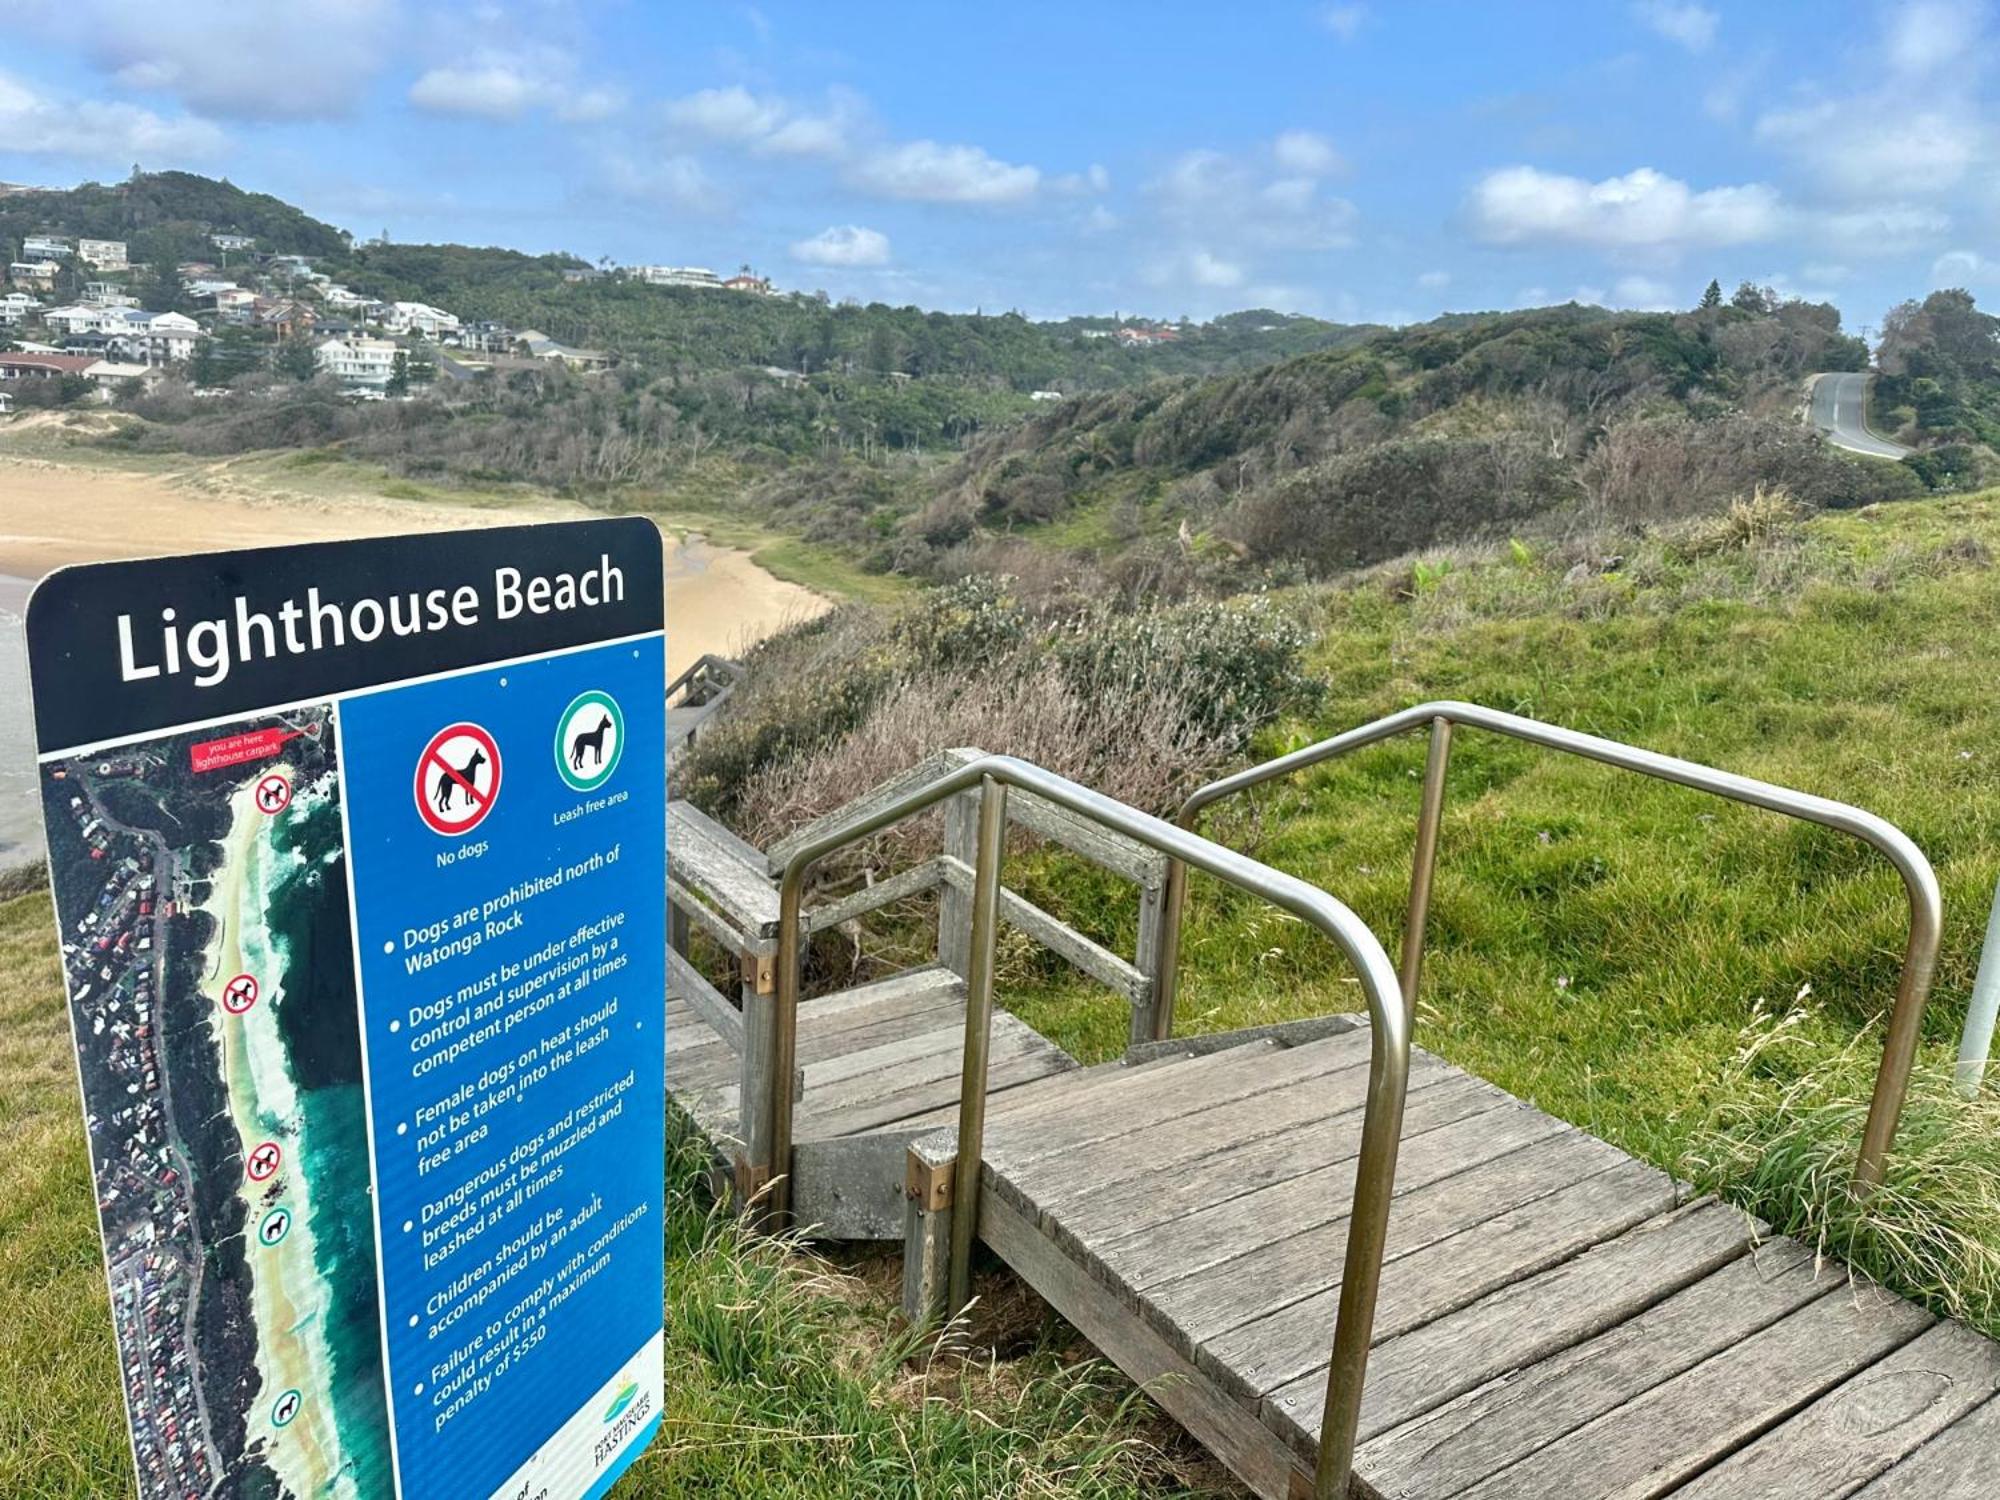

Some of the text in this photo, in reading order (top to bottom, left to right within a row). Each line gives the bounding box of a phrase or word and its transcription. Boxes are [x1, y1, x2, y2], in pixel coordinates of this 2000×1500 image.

[117, 554, 624, 687] Lighthouse Beach
[195, 742, 278, 769] lighthouse carpark
[209, 735, 264, 755] you are here
[437, 841, 488, 867] No dogs
[554, 791, 628, 825] Leash free area
[404, 844, 619, 949] Dogs are prohibited north of
[405, 910, 523, 975] Watonga Rock
[409, 913, 624, 1027] Dogs must be under effective
[411, 938, 618, 1052] control and supervision by a
[413, 954, 627, 1077] competent person at all times
[416, 997, 617, 1127] Female dogs on heat should
[418, 1026, 609, 1152] not be taken into the leash
[418, 1125, 488, 1176] free area
[422, 1070, 634, 1224] Dangerous dogs and restricted
[423, 1099, 622, 1247] breeds must be muzzled and
[424, 1165, 563, 1270] leashed at all times
[427, 1208, 563, 1315] Children should be
[429, 1196, 602, 1339] accompanied by an adult
[432, 1203, 647, 1384] Failure to comply with conditions
[433, 1253, 610, 1405] could result in a maximum
[436, 1325, 546, 1432] penalty of $550
[594, 1403, 650, 1467] HASTINGS
